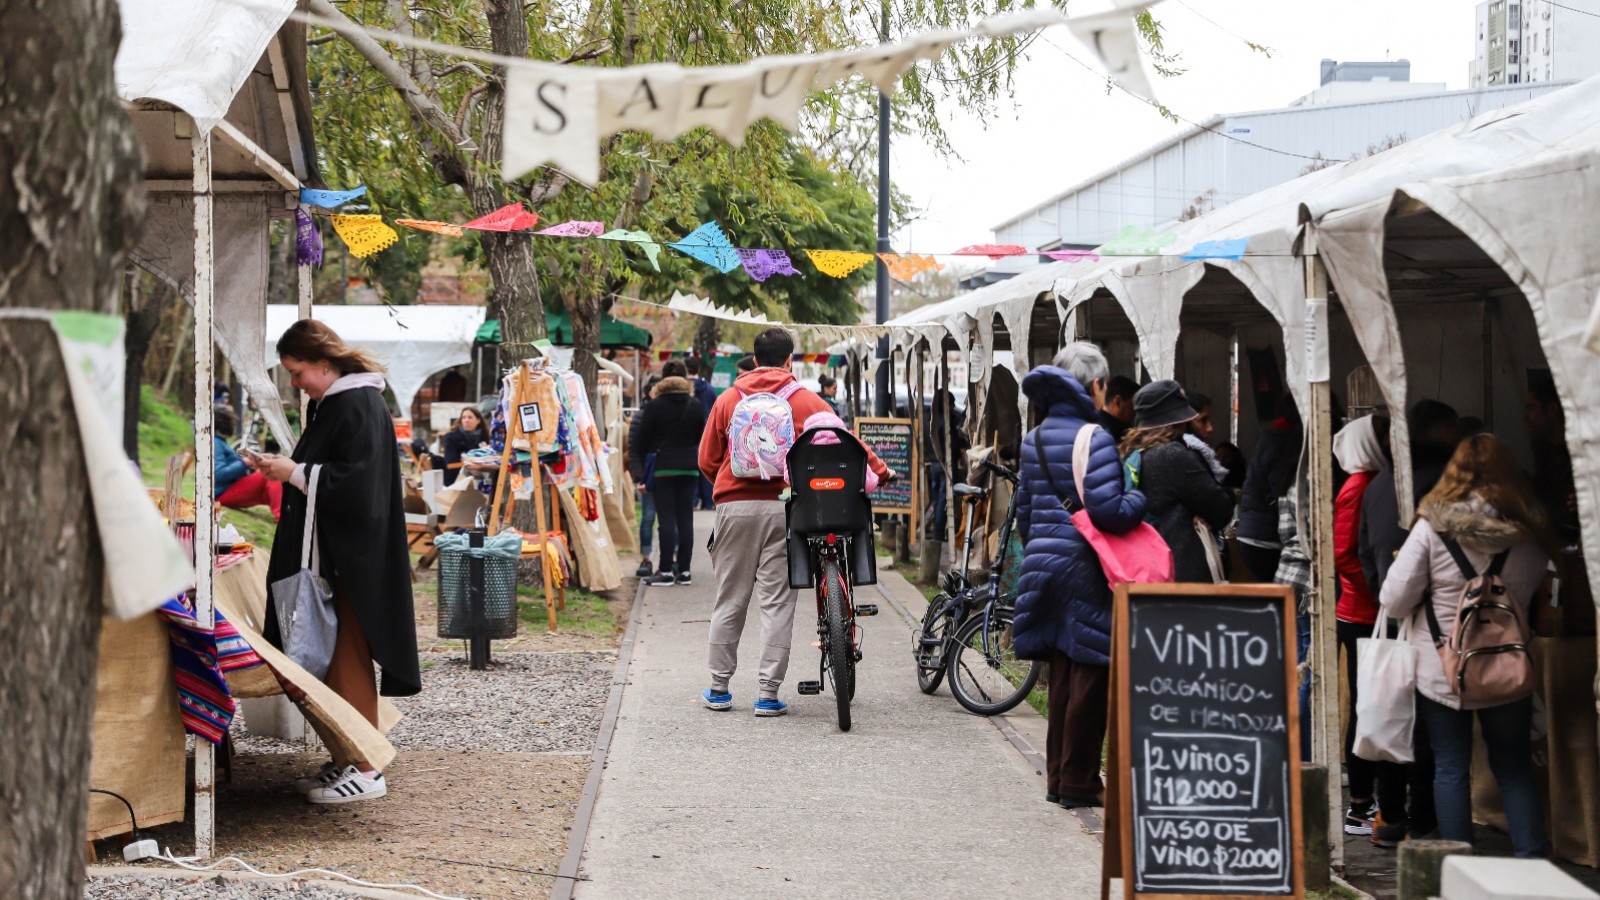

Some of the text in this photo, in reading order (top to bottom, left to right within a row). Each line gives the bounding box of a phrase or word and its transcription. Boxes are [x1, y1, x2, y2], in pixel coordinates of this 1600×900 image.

[861, 434, 907, 443] Empanadas
[1150, 746, 1171, 770] 2
[1147, 820, 1210, 839] VASO
[1151, 840, 1281, 874] VINO $2000
